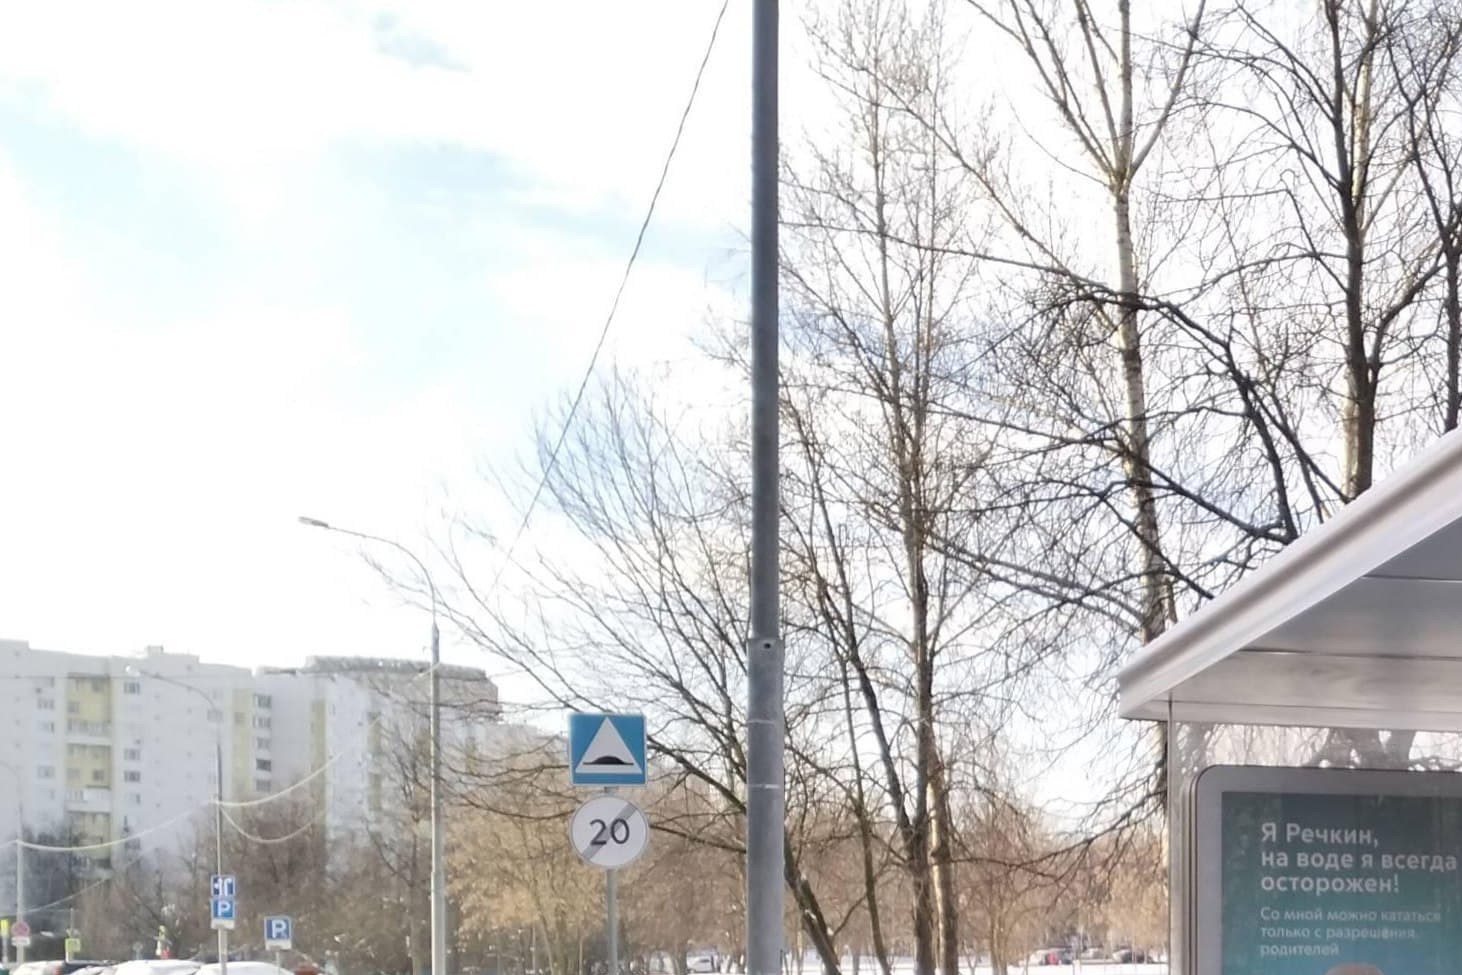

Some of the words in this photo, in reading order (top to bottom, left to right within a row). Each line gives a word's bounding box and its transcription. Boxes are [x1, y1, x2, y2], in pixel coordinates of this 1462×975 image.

[589, 818, 631, 846] 20
[1261, 822, 1277, 843] Я
[1286, 823, 1379, 848] Речкин,
[1261, 852, 1288, 868] на
[1296, 852, 1354, 871] воде
[1361, 854, 1374, 869] я
[1381, 854, 1457, 873] всегда
[1260, 873, 1400, 897] осторожен!
[217, 901, 231, 917] P
[1260, 906, 1280, 921] Со
[1284, 907, 1323, 922] мной
[1327, 909, 1378, 922] можно
[1381, 910, 1442, 923] кататься
[271, 919, 287, 939] P
[1260, 926, 1311, 939] только
[1314, 928, 1322, 939] с
[1260, 942, 1340, 958] родителей
